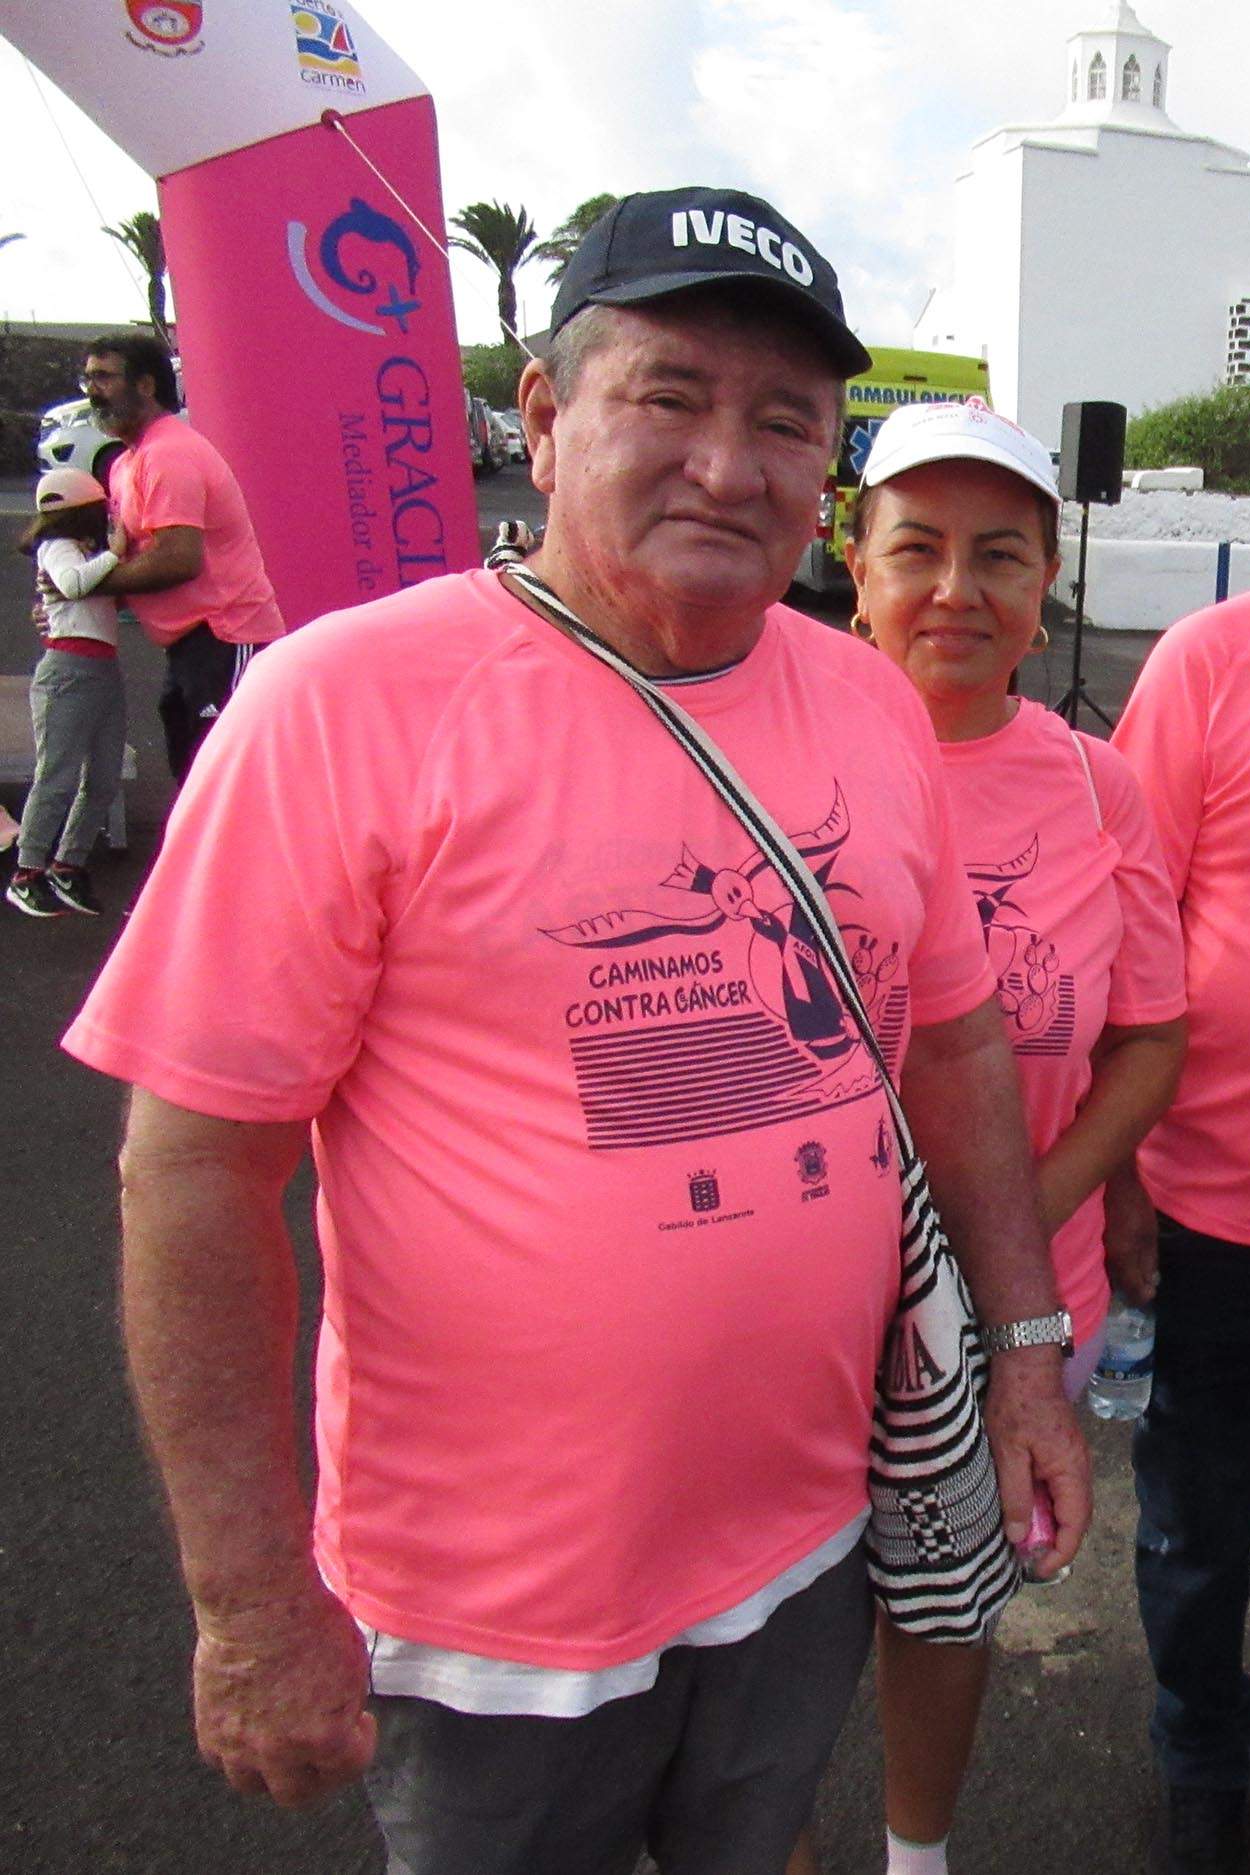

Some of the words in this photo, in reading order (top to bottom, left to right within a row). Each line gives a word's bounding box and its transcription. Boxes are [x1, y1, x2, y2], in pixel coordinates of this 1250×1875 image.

[672, 209, 814, 287] IVECO
[849, 384, 970, 405] AMBULANCI
[339, 412, 377, 551] Mediador
[356, 557, 383, 592] de
[588, 950, 724, 989] CAMINAMOS
[564, 990, 671, 1028] CONTRA
